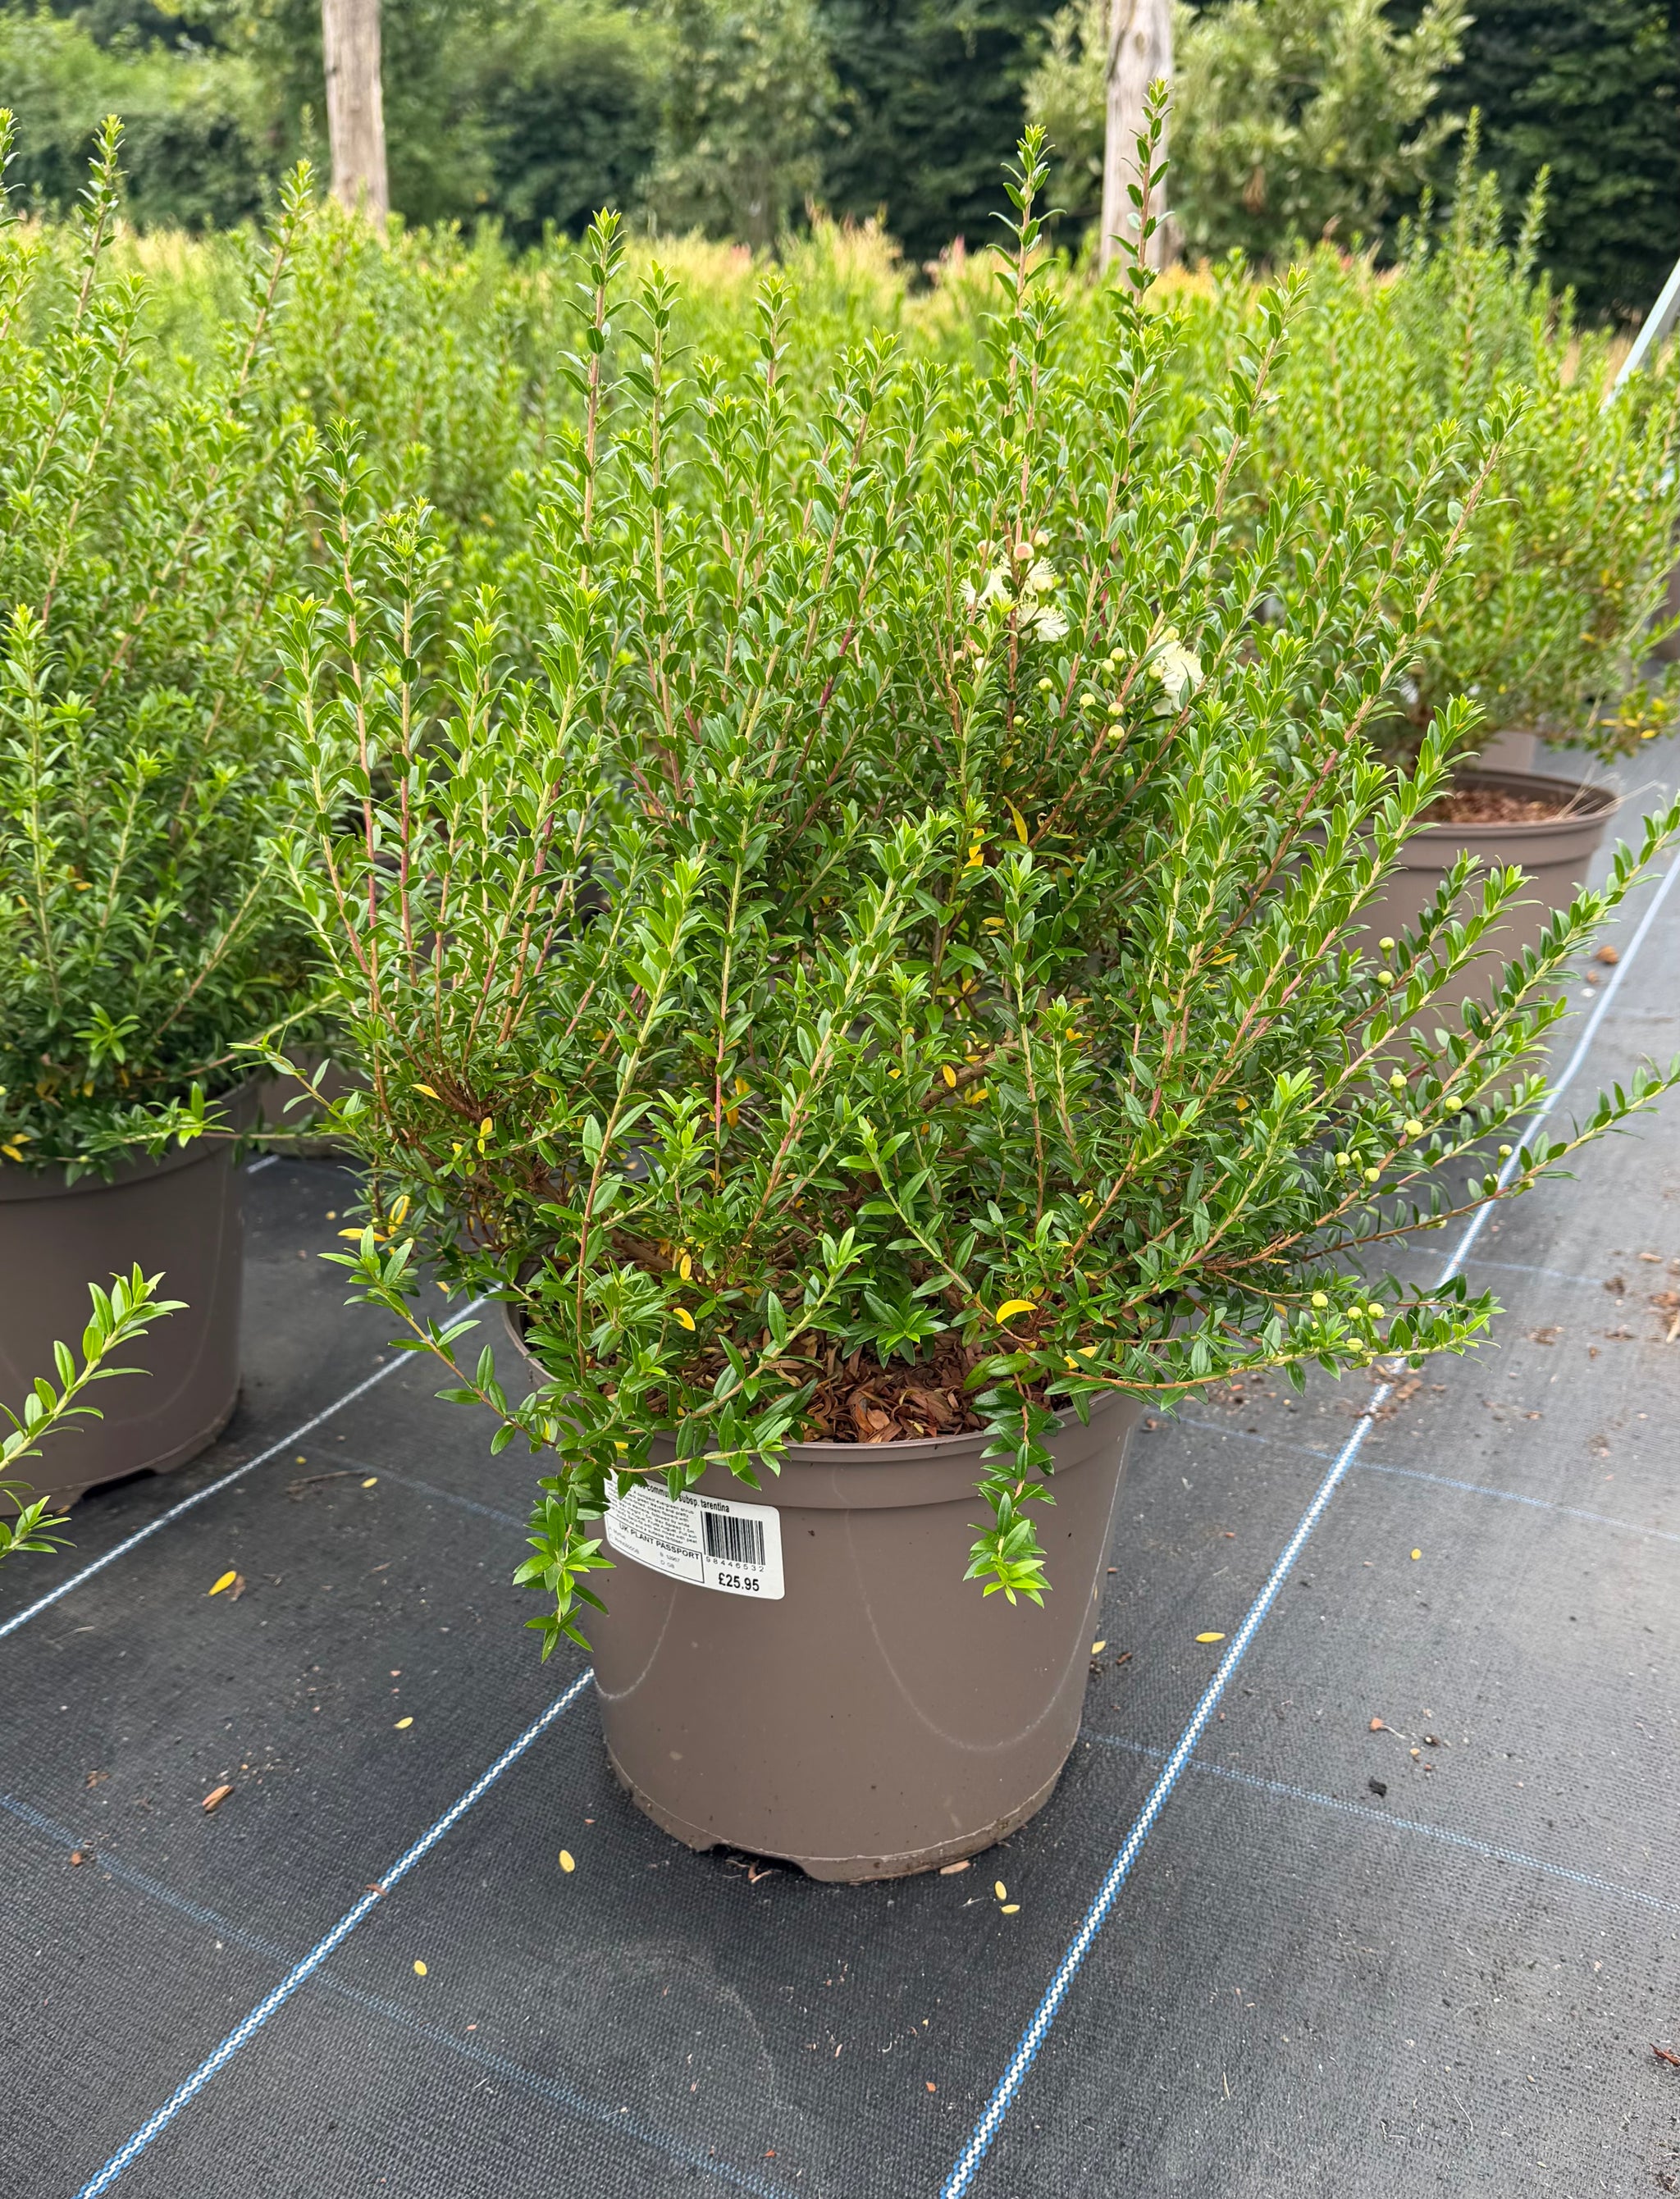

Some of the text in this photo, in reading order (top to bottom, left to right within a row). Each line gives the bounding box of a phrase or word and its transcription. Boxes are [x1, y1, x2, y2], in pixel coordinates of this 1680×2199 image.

[678, 1494, 700, 1508] subsp.
[700, 1499, 730, 1513] tarentina
[619, 1522, 629, 1533] UK
[631, 1529, 655, 1544] PLANT
[656, 1540, 700, 1560] PASSPORT
[705, 1556, 765, 1572] 98446532
[718, 1572, 760, 1591] £25.95
